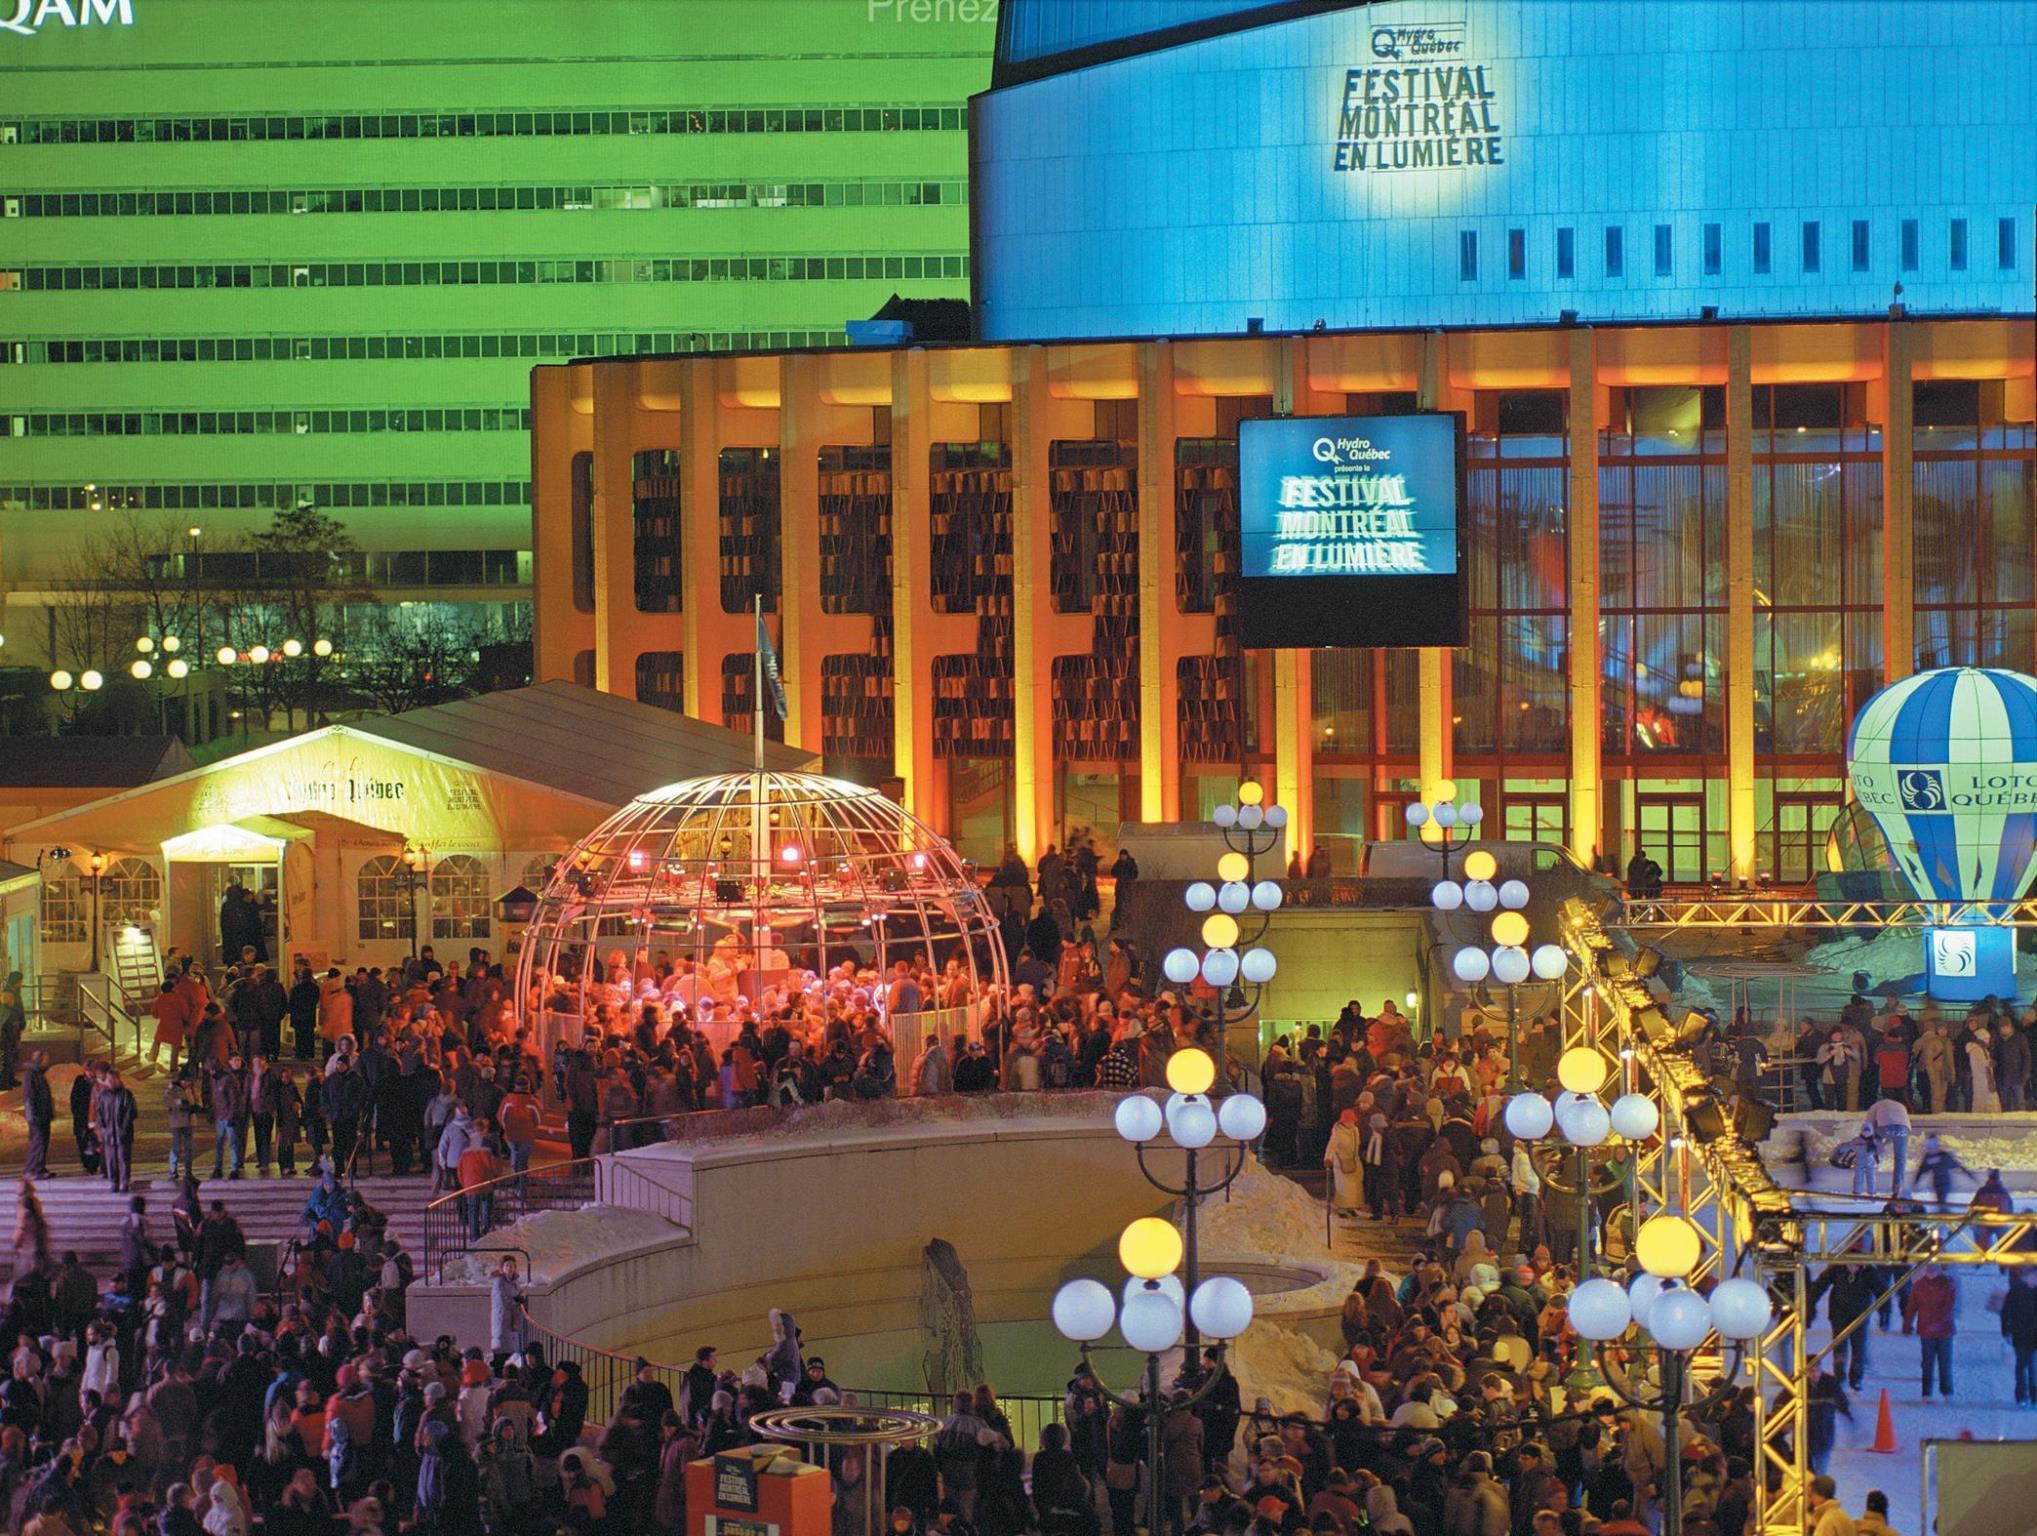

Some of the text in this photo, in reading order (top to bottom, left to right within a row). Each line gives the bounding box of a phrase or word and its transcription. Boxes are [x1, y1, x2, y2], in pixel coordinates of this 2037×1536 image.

[867, 0, 998, 22] Prenez
[1397, 28, 1435, 46] Hydro
[1343, 65, 1495, 105] FESTIVAL
[1338, 99, 1500, 140] MONTRÉAL
[1334, 129, 1505, 171] EN LUMIÈRE
[1337, 437, 1370, 451] Hydro
[1349, 448, 1391, 460] Québec
[1281, 476, 1412, 507] FESTIVAL
[1278, 504, 1418, 540] MONTRÉAL
[1274, 539, 1426, 570] EN LUMIÈRE
